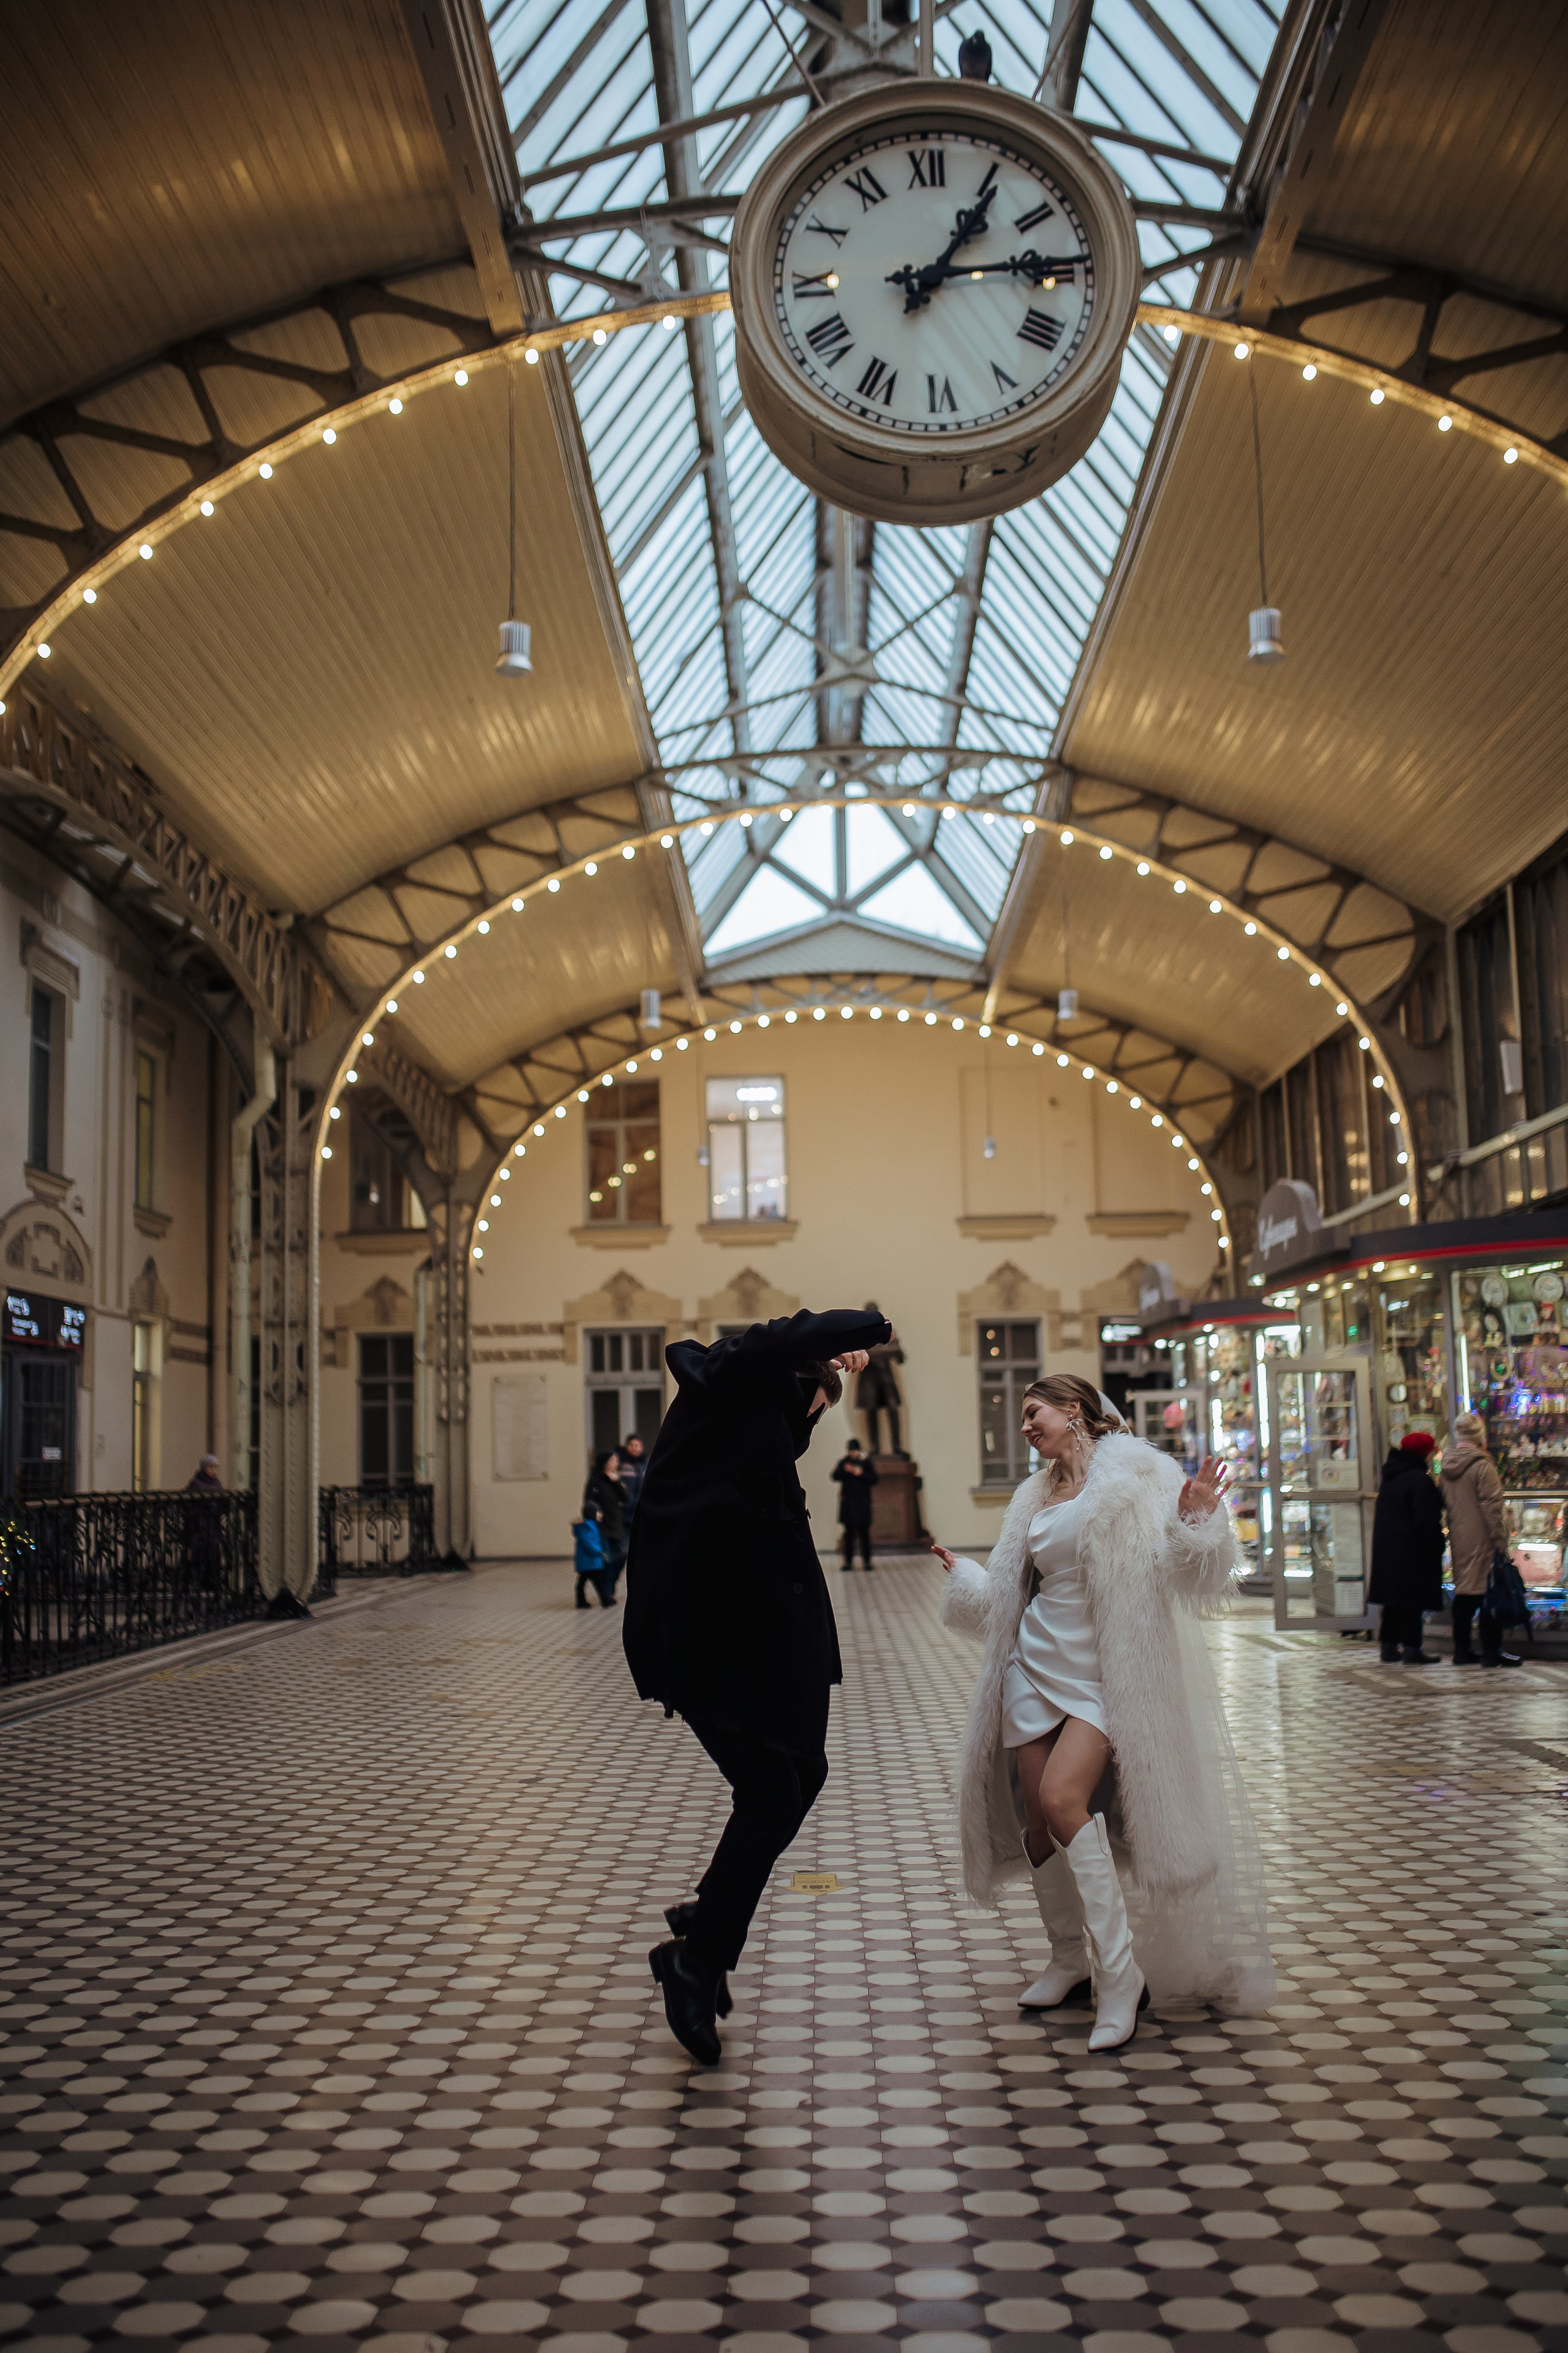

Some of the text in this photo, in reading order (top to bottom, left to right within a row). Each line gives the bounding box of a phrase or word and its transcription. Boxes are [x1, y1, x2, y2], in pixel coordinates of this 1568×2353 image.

[908, 149, 946, 189] XII
[843, 166, 889, 213] XI
[804, 213, 850, 248] X
[1013, 202, 1055, 234] II
[792, 268, 837, 301] IX
[805, 313, 856, 369] VIII
[1017, 306, 1066, 352] IIII
[856, 355, 898, 406] VII
[925, 373, 959, 414] VI
[989, 360, 1019, 396] V
